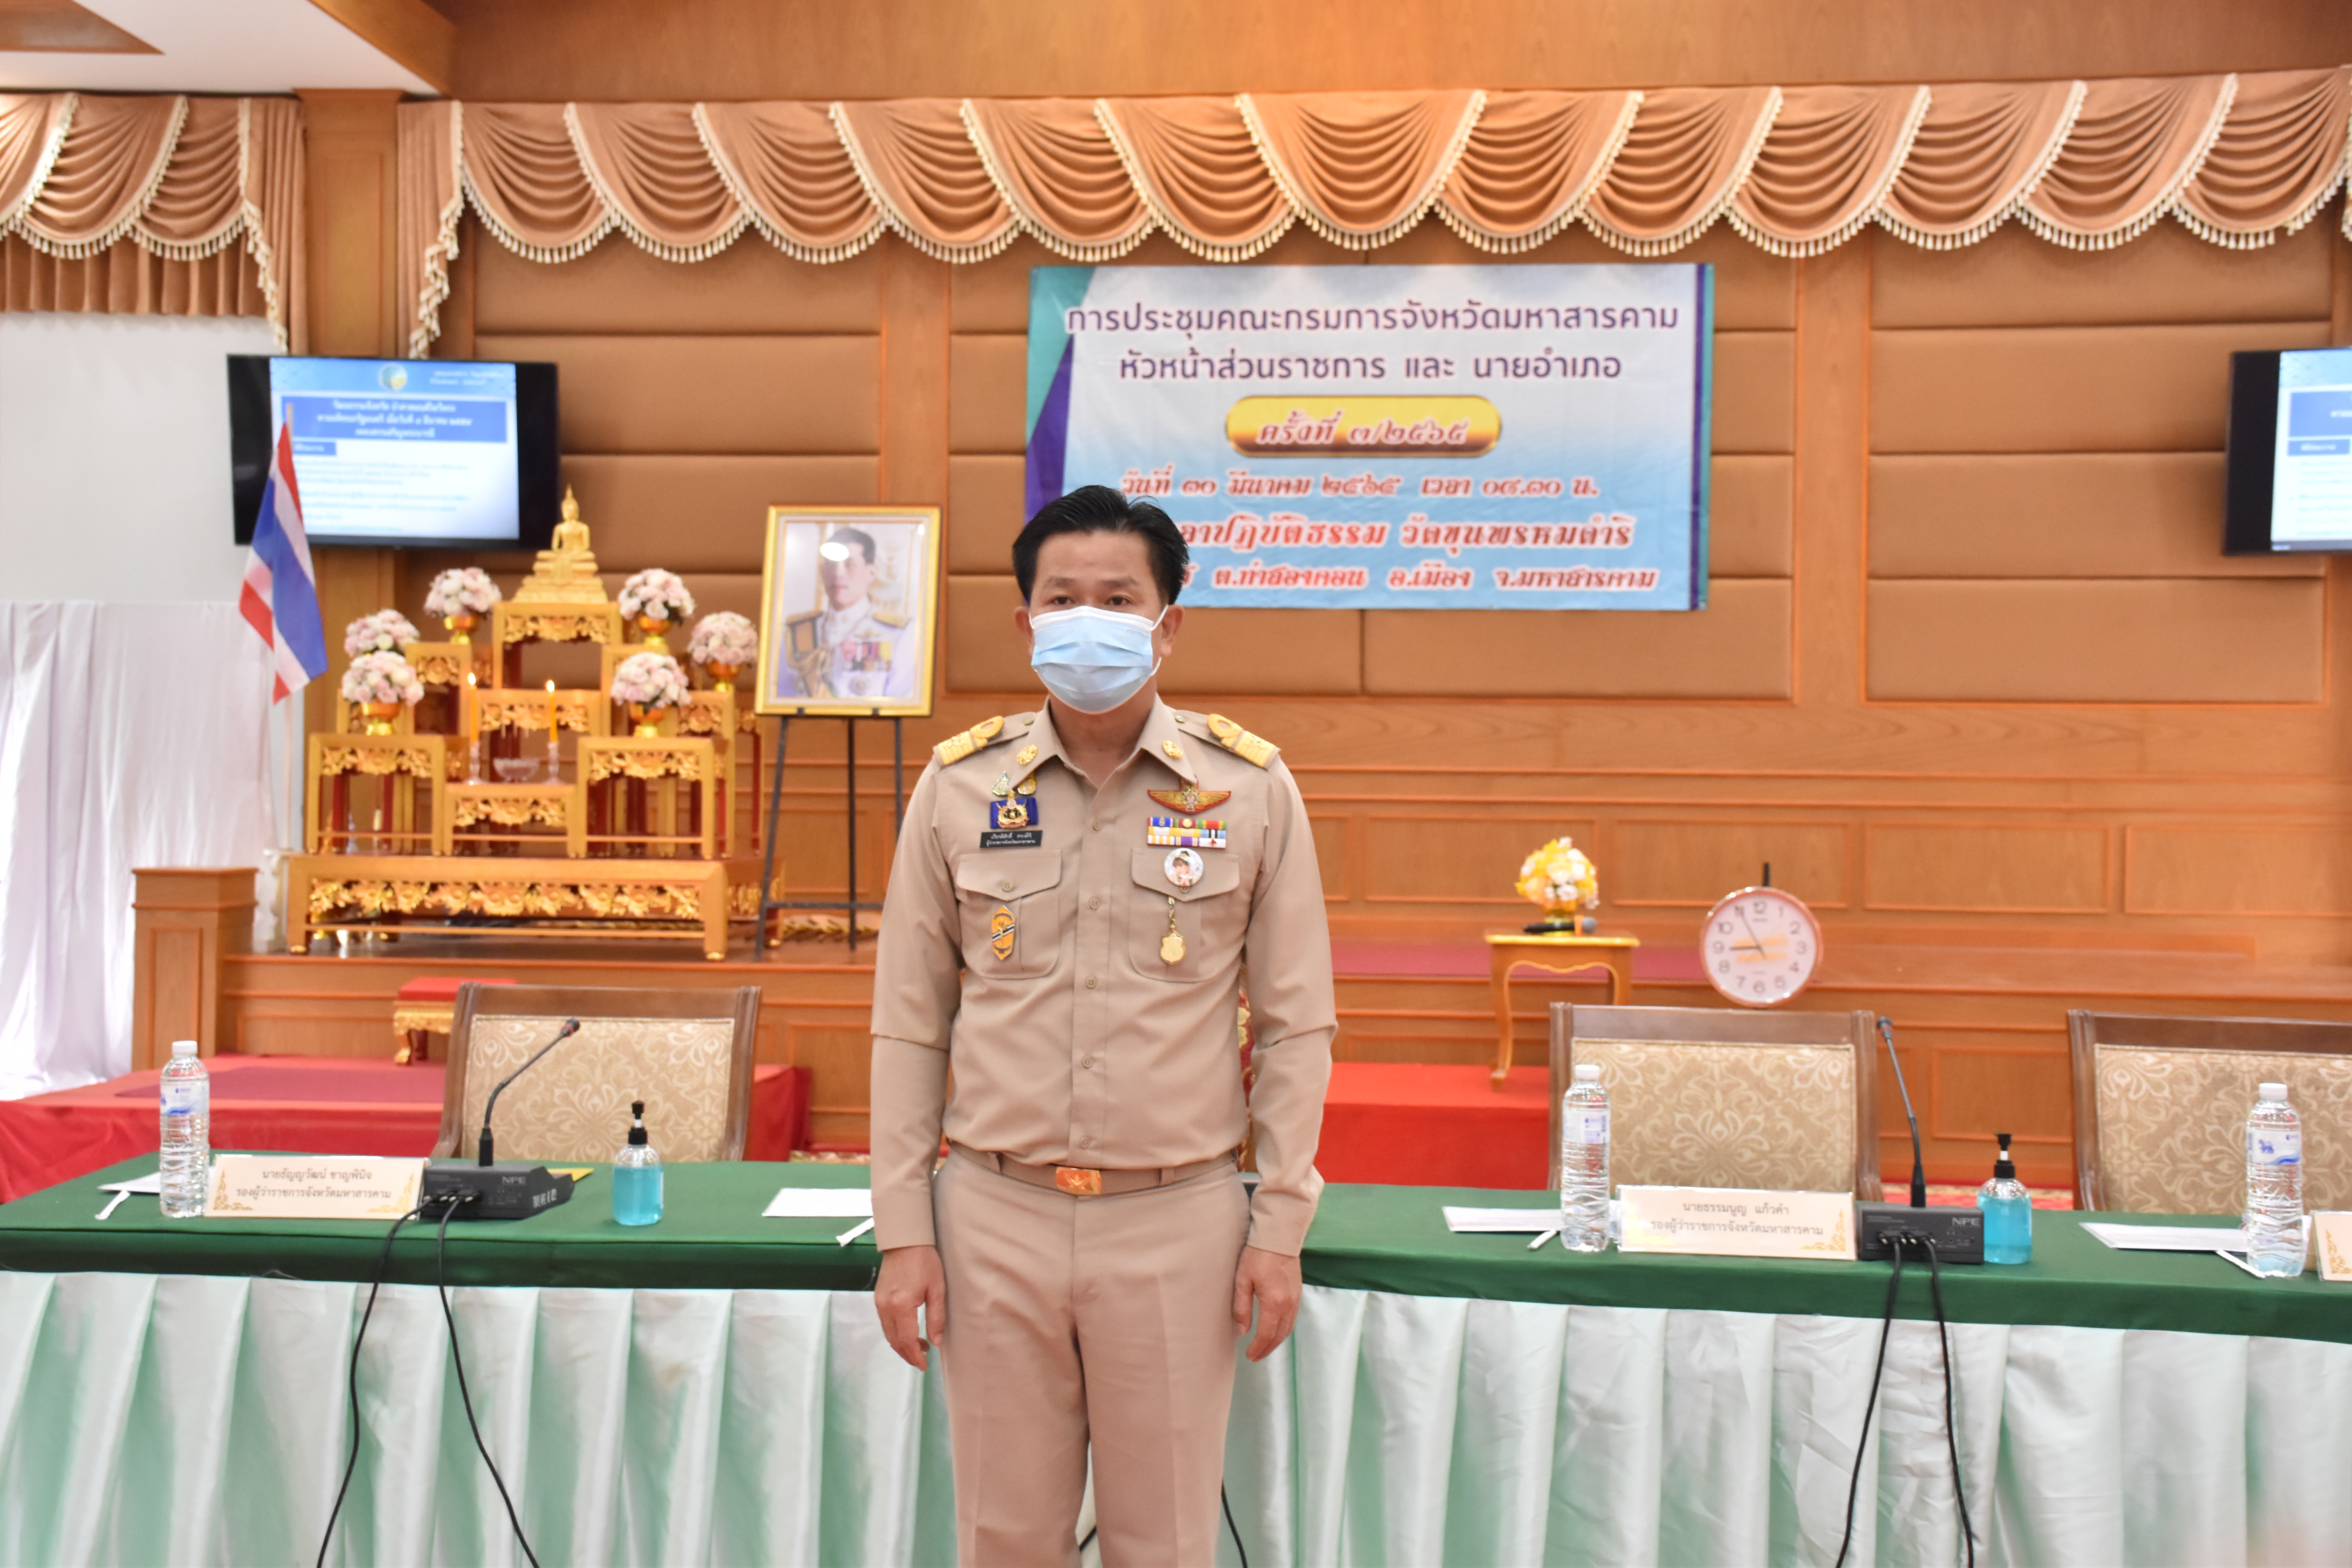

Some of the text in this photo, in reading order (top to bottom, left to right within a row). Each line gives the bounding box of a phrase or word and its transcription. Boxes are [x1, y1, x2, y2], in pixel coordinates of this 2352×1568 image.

[1068, 299, 1679, 340] การประชุมคณะกรมการจังหวัดมหาสารคาม
[1120, 347, 1622, 379] หัวหน้าส่วนราชการ และ นายอำเภอ
[1258, 410, 1342, 443] ครั้งที่
[1122, 465, 1174, 495] วันที่
[1227, 470, 1313, 495] มีนาคม
[1421, 478, 1472, 495] เวลา
[1572, 478, 1599, 495] น.
[1401, 514, 1635, 556] วัดขุนพรหมดำริ
[1214, 561, 1367, 586] ต.ท่าสองคอน
[1389, 562, 1472, 587] อ.เมือง
[1494, 566, 1657, 588] จ.มหาสารคาม
[1753, 901, 1767, 915] 12
[1718, 921, 1734, 935] 10
[1789, 920, 1801, 934] 2
[502, 1176, 527, 1185] NPE
